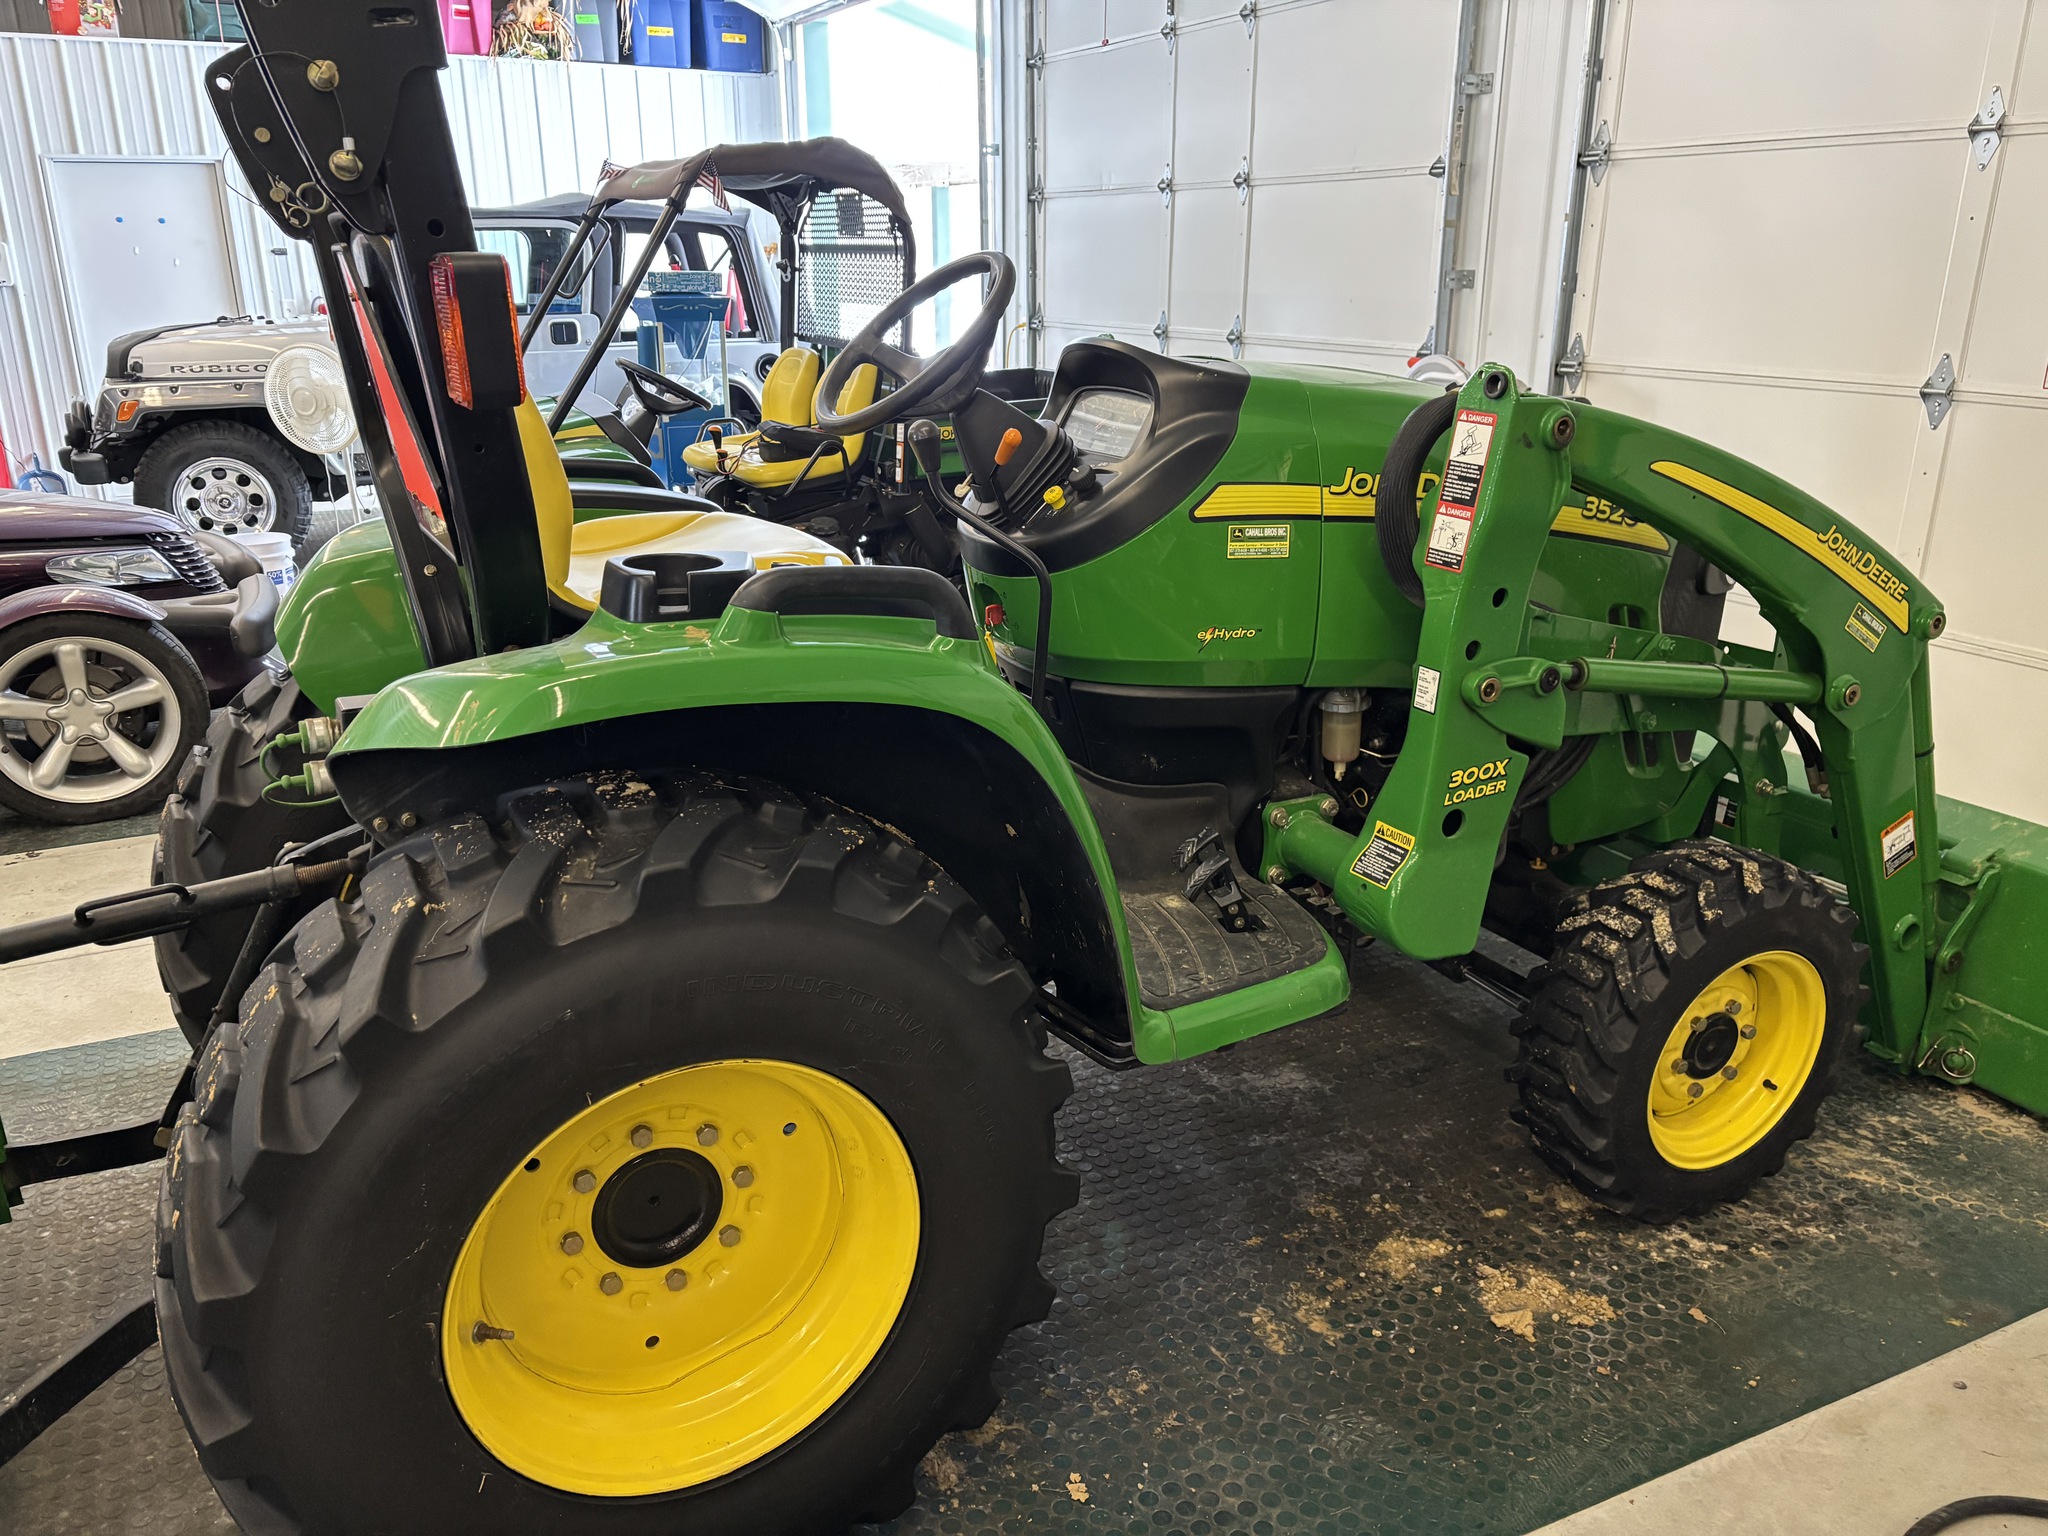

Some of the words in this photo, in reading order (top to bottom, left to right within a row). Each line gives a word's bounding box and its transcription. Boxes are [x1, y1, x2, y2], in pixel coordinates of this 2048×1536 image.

[170, 365, 268, 373] RUBICO
[1468, 414, 1494, 424] DANGER
[1447, 508, 1471, 518] DANGER
[1582, 496, 1636, 526] 352
[1265, 528, 1277, 536] BROS
[1817, 525, 1862, 567] JOHN
[1857, 551, 1910, 602] DEERE
[1448, 758, 1511, 789] 300X
[1443, 780, 1507, 806] LOADER
[1385, 828, 1412, 847] CAUTION
